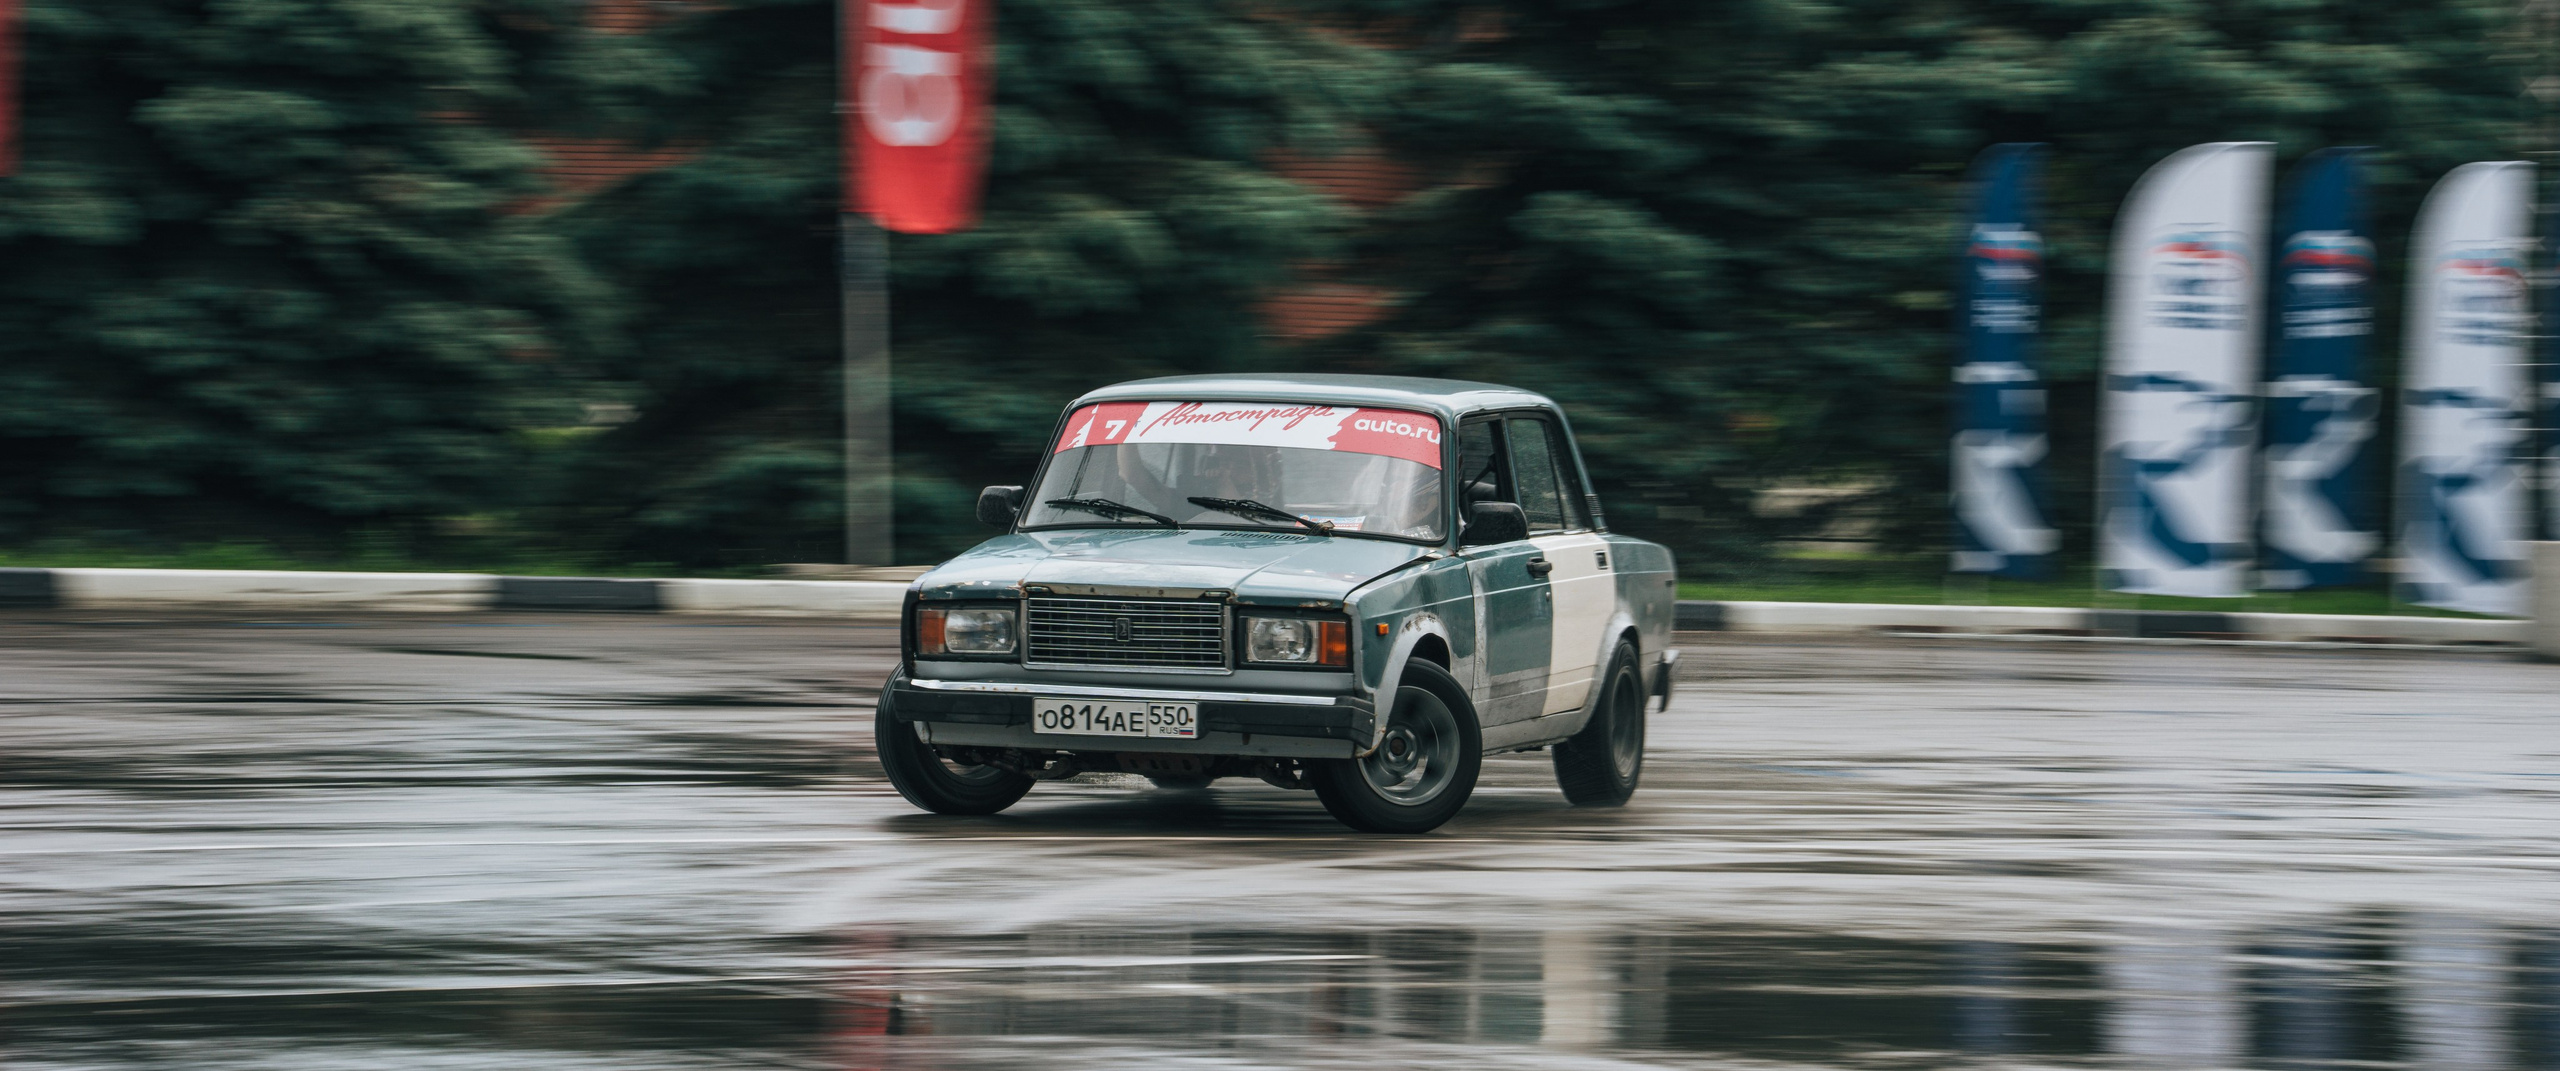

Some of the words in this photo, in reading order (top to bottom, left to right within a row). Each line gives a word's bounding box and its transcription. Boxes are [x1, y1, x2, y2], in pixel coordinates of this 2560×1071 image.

[1139, 401, 1335, 437] Автострада
[1105, 420, 1128, 440] 7
[1354, 418, 1440, 445] auto.ru
[1149, 705, 1189, 726] 550
[1160, 727, 1179, 735] RUS
